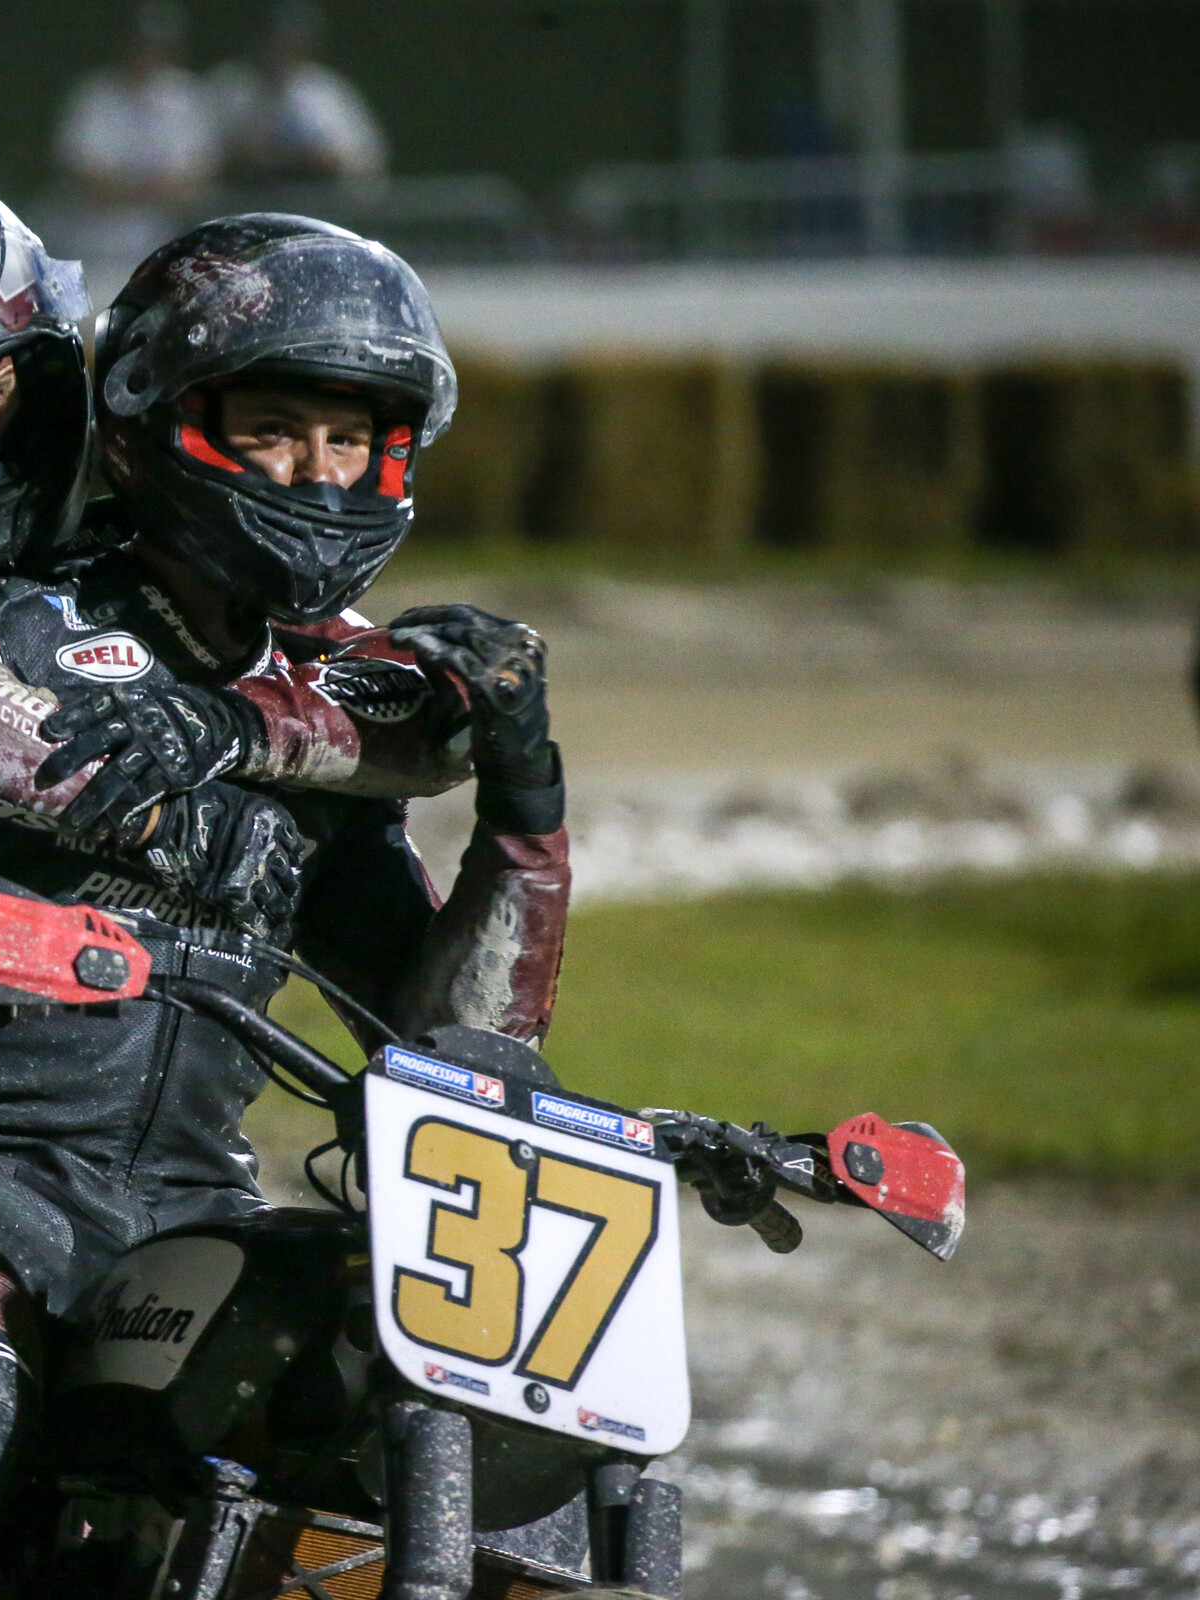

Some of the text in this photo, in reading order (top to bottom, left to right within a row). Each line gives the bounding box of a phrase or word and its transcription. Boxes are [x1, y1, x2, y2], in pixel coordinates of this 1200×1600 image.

[71, 645, 140, 668] BELL
[391, 1052, 471, 1087] PROGRESSIVE
[537, 1098, 620, 1131] PROGRESSIVE
[391, 1114, 662, 1392] 37
[97, 1278, 195, 1344] Indian
